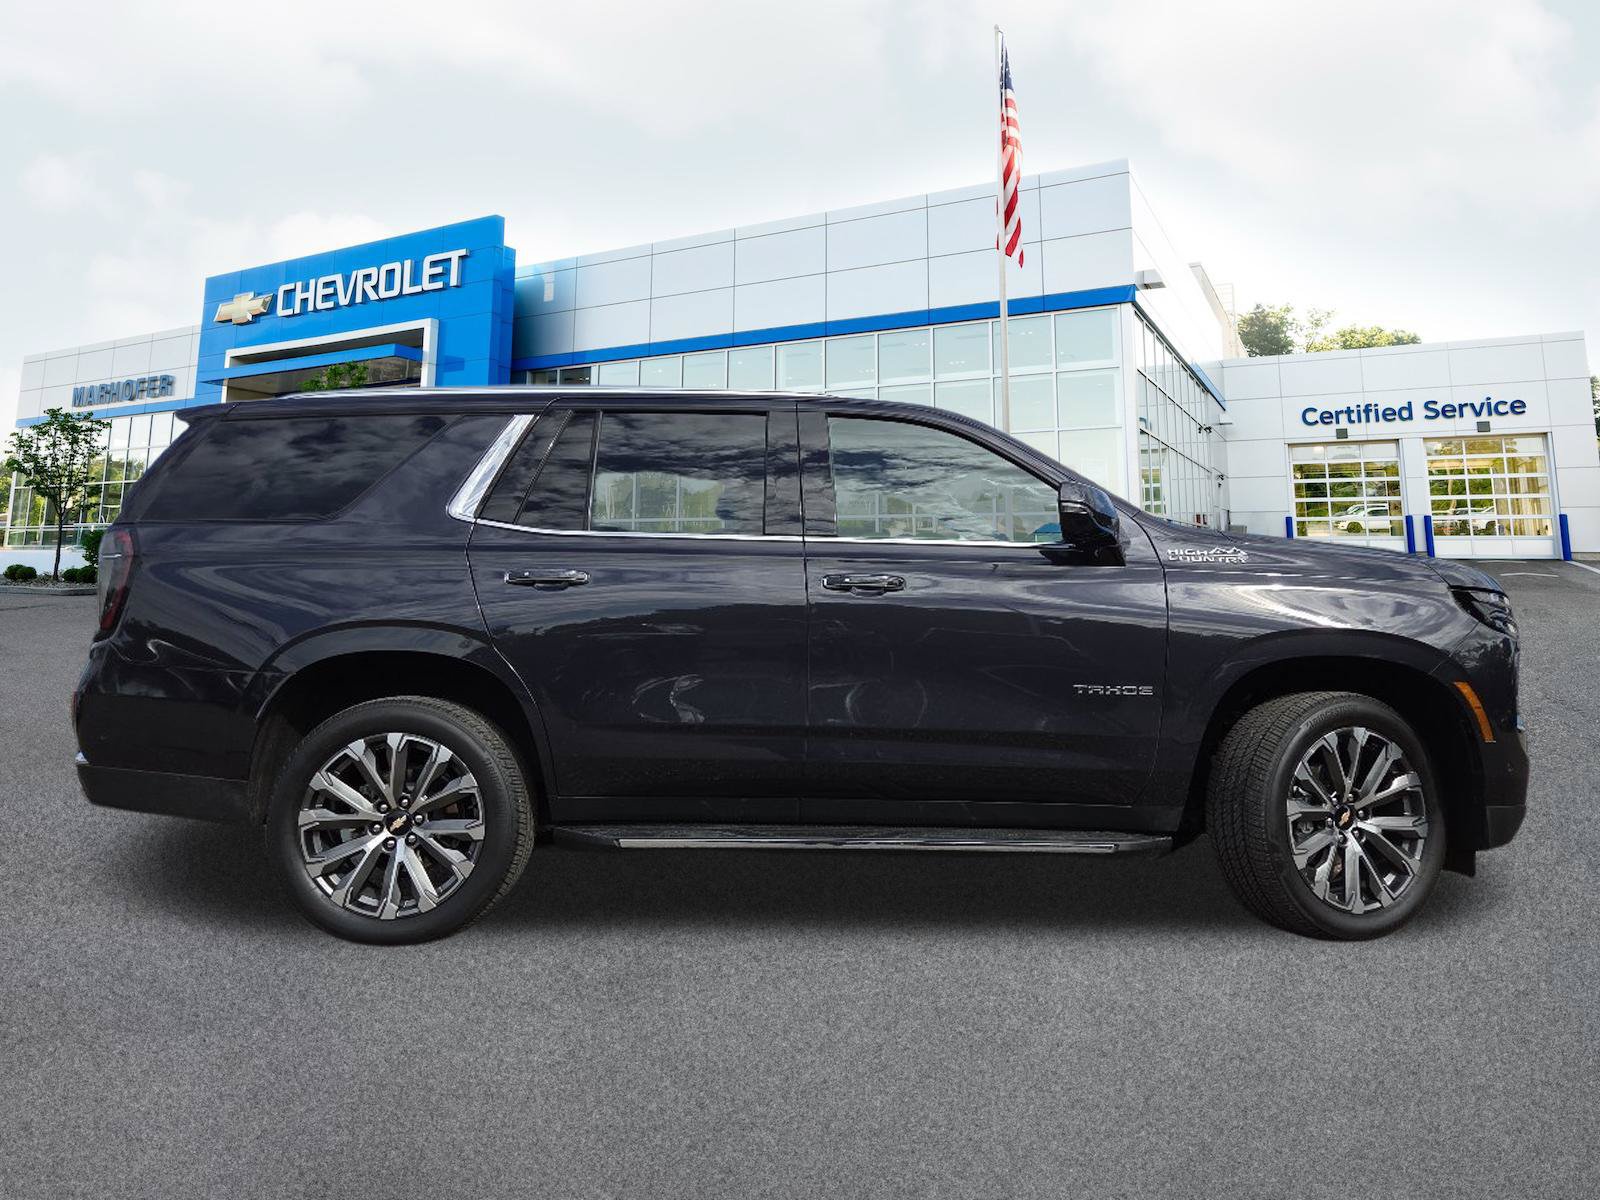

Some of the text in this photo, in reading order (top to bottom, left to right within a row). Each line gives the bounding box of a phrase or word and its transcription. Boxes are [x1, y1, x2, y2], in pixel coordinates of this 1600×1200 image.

[276, 248, 470, 317] CHEVROLET
[72, 375, 175, 407] MARHOFER
[1302, 396, 1527, 426] Certified Service
[1168, 554, 1247, 564] COUNTRY
[1072, 684, 1154, 696] TAHOE
